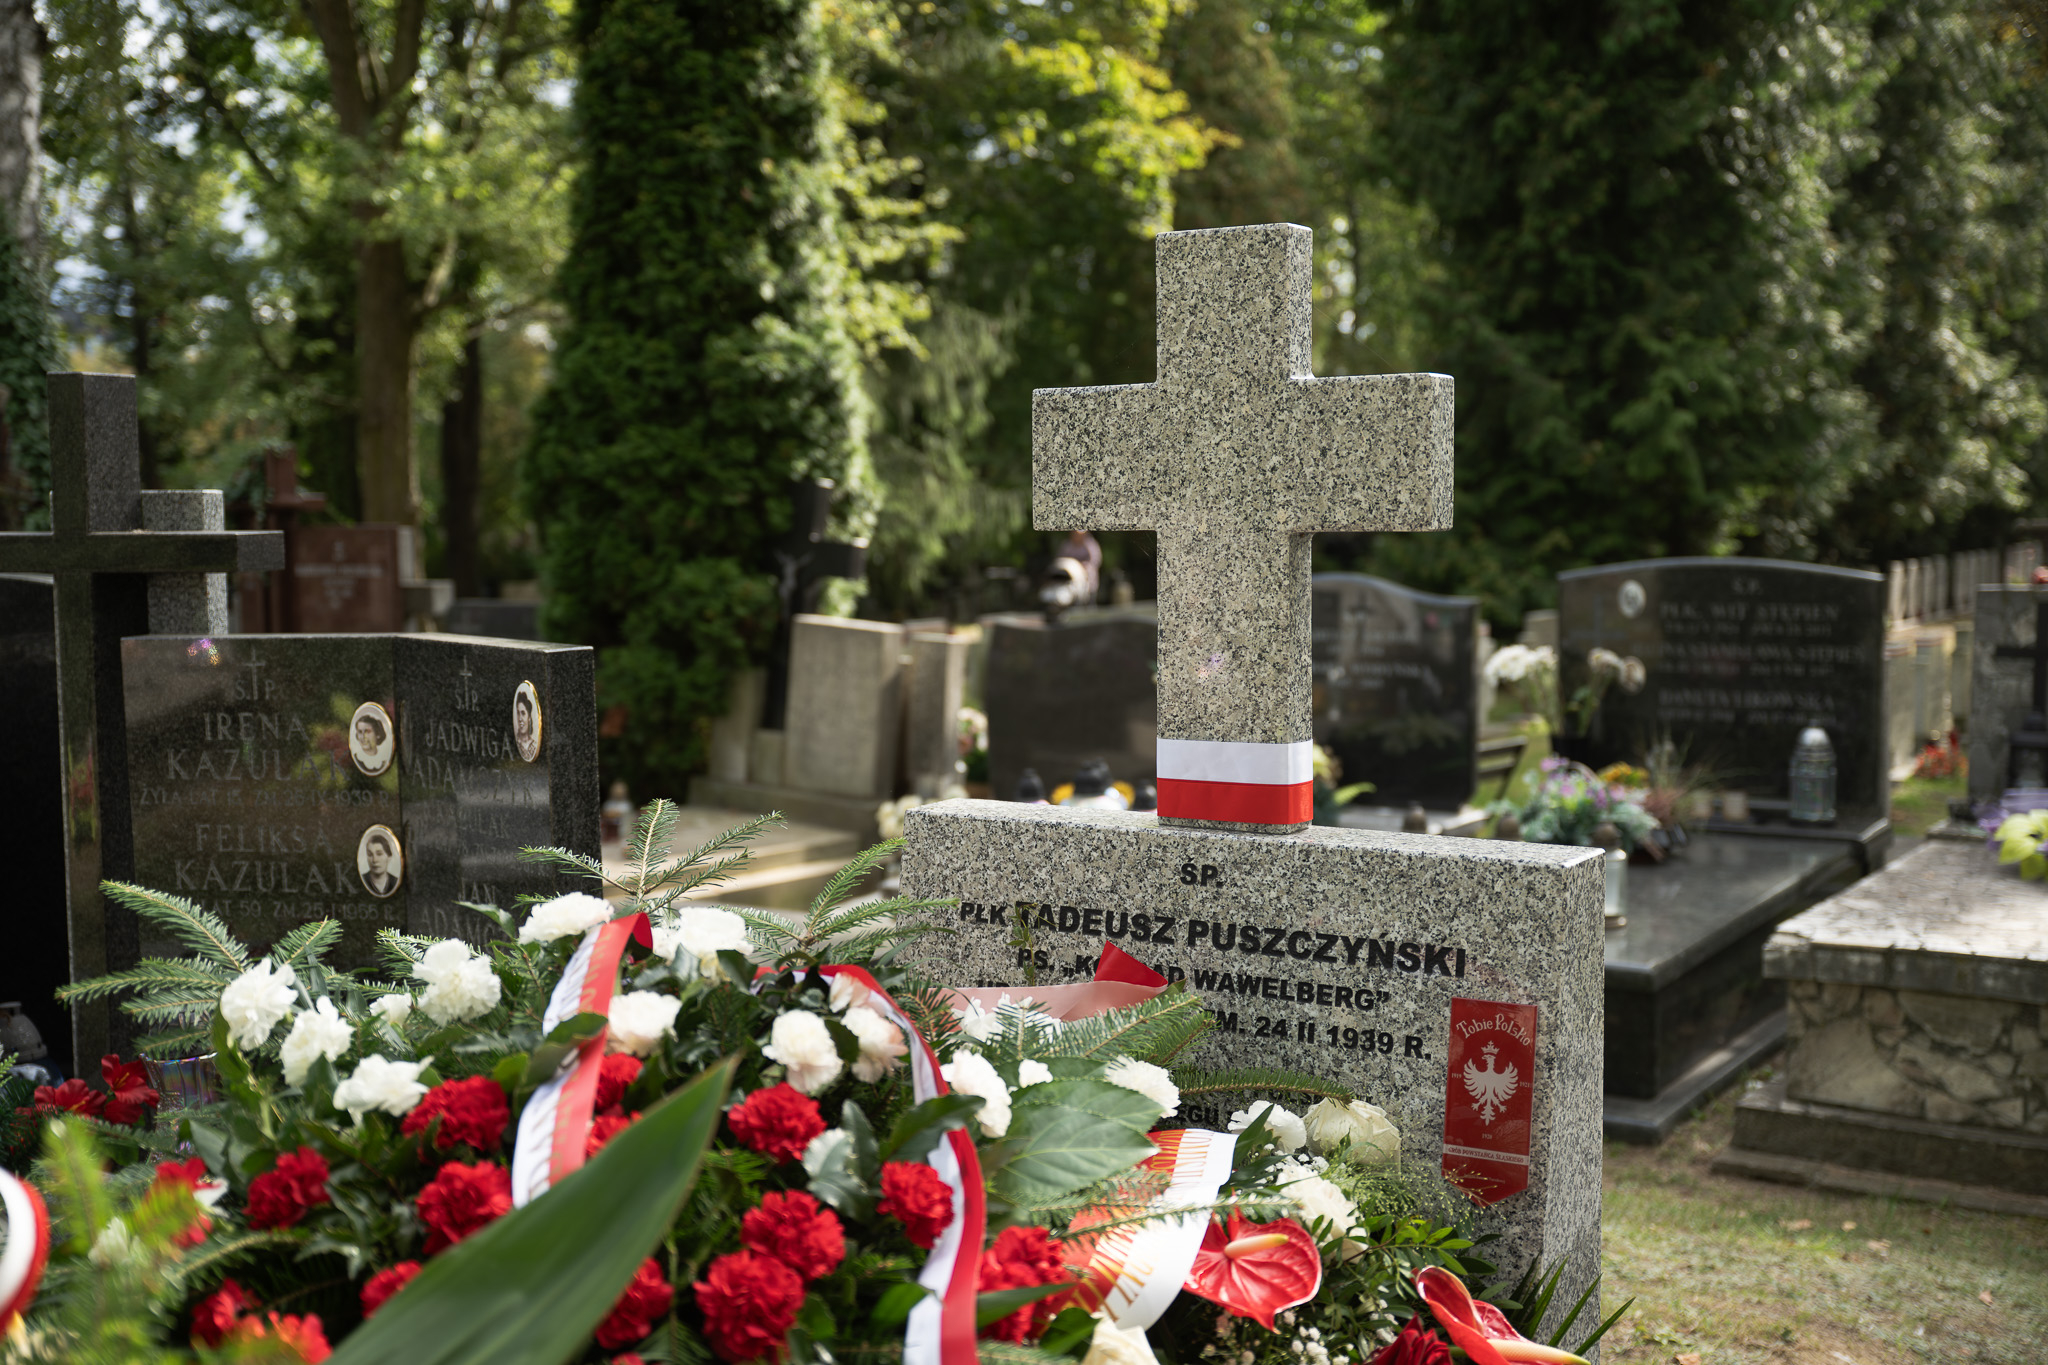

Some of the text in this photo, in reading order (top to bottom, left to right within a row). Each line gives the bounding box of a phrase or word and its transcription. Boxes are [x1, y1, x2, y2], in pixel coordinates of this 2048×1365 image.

[203, 711, 310, 742] IRENA
[425, 718, 514, 762] JADWIGA
[166, 748, 352, 781] KAZULAK
[195, 823, 333, 854] FELIKSA
[174, 860, 358, 895] KAZULAK
[1180, 857, 1223, 888] ŚP.
[457, 878, 497, 905] JAN
[960, 901, 1466, 978] PŁK TADEUSZ PUSZCZYŃSKI
[1017, 949, 1054, 973] PS.
[1202, 1008, 1432, 1060] M. 24 II 1939 R.
[1456, 1013, 1531, 1046] Tobie Polsko
[1448, 1146, 1461, 1154] GRÓB
